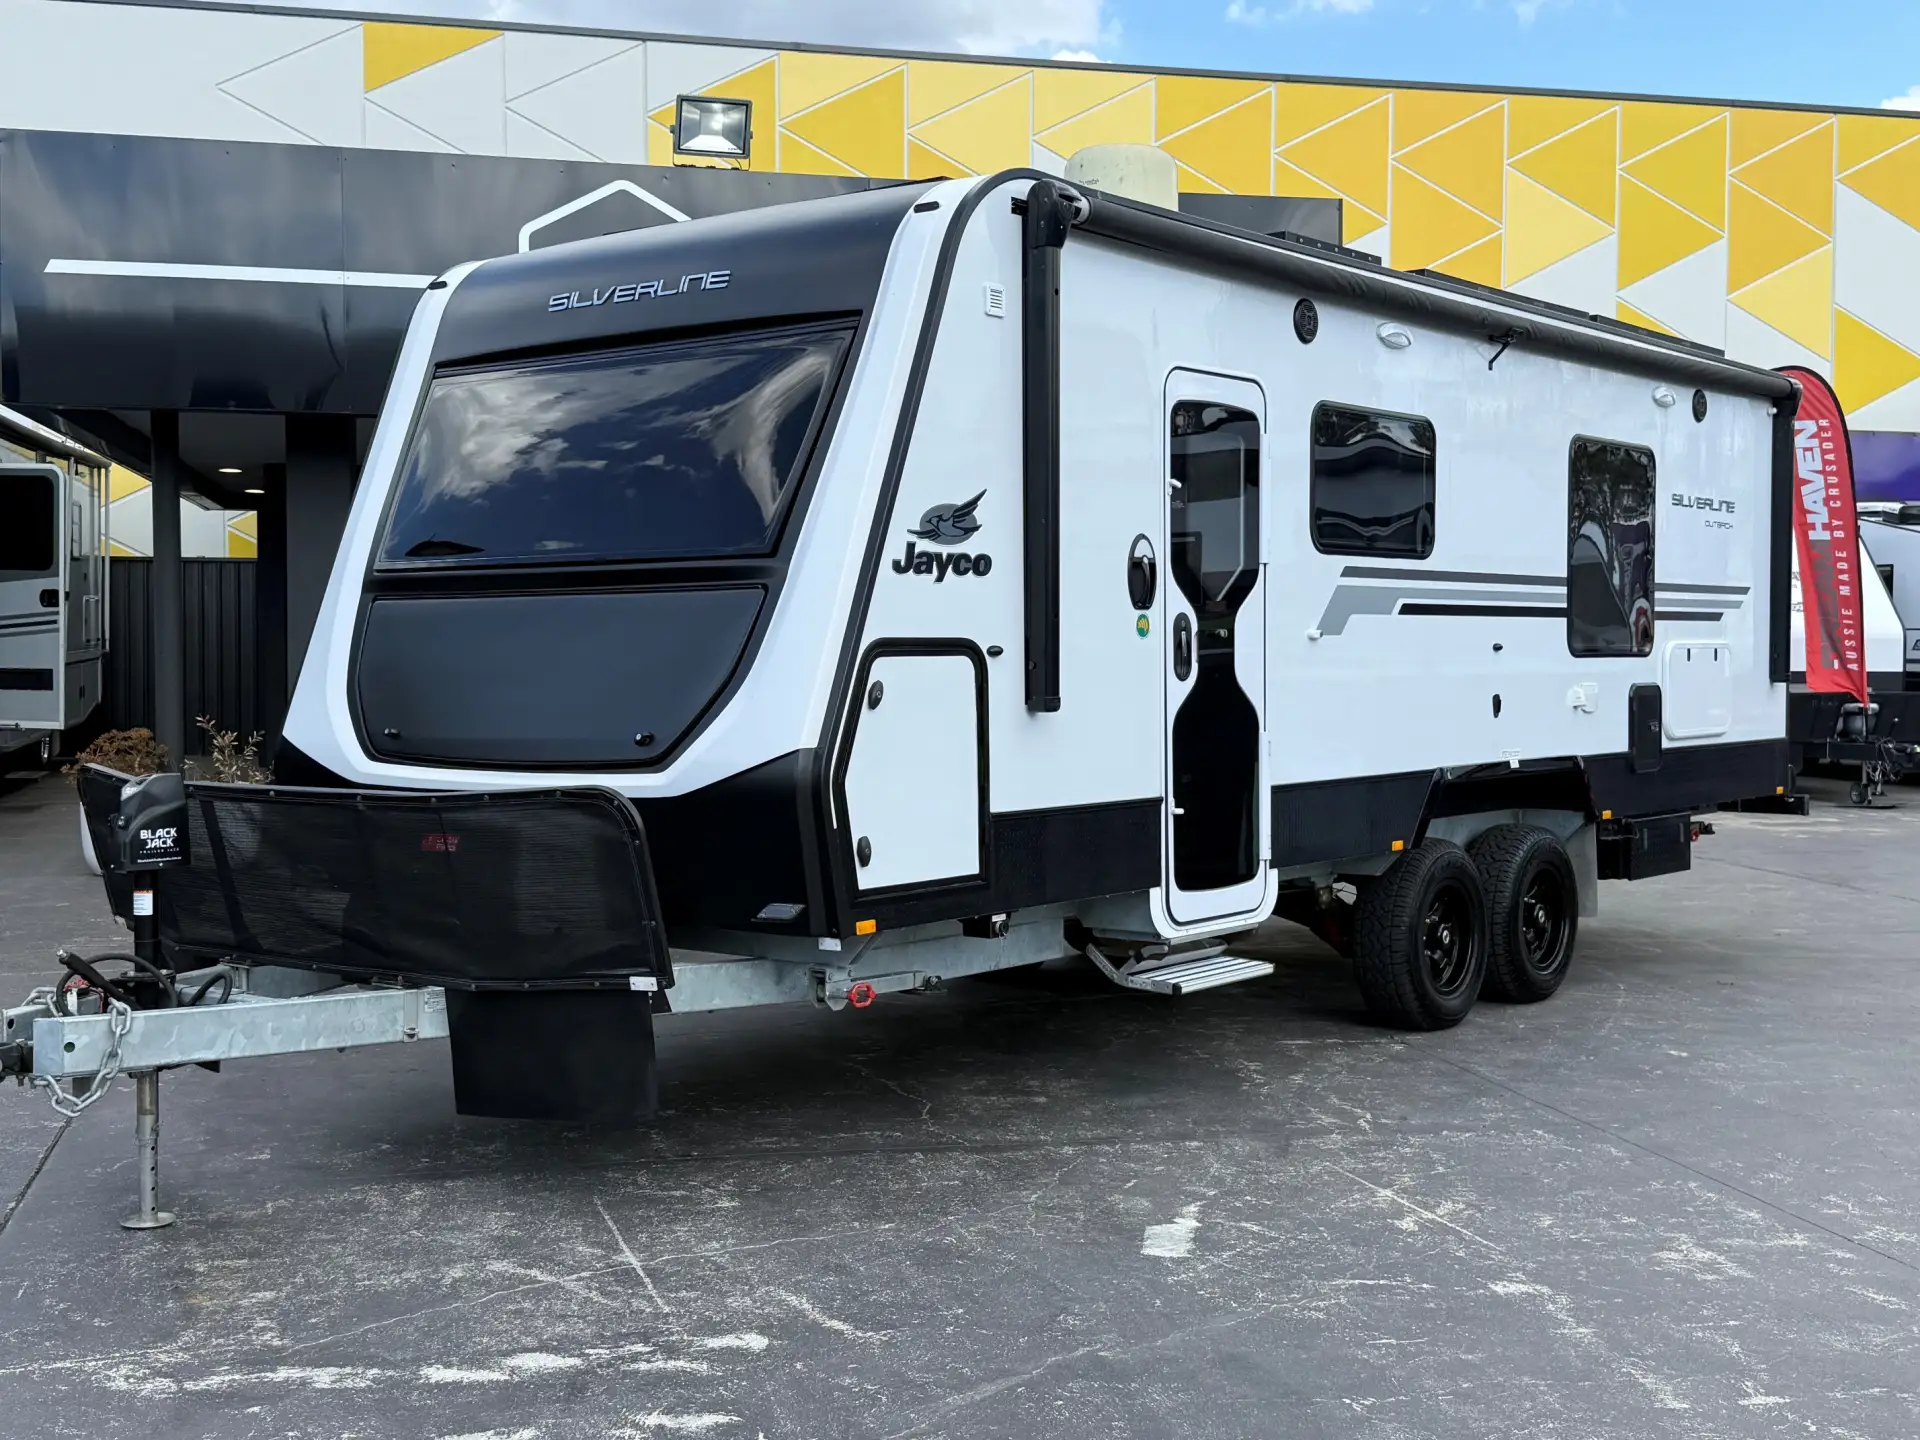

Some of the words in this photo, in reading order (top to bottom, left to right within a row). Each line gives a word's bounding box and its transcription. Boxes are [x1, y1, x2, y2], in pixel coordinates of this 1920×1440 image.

[548, 270, 731, 312] SILVERLINE
[1794, 420, 1831, 540] HAVEN
[1818, 419, 1841, 507] CRUSADER
[1671, 493, 1735, 513] SILVERLINE
[1832, 519, 1845, 538] BY
[892, 541, 992, 583] Jayco
[1835, 550, 1851, 596] MADE
[1841, 608, 1858, 671] AUSSIE
[140, 827, 177, 839] BLACK
[145, 838, 174, 848] JACK
